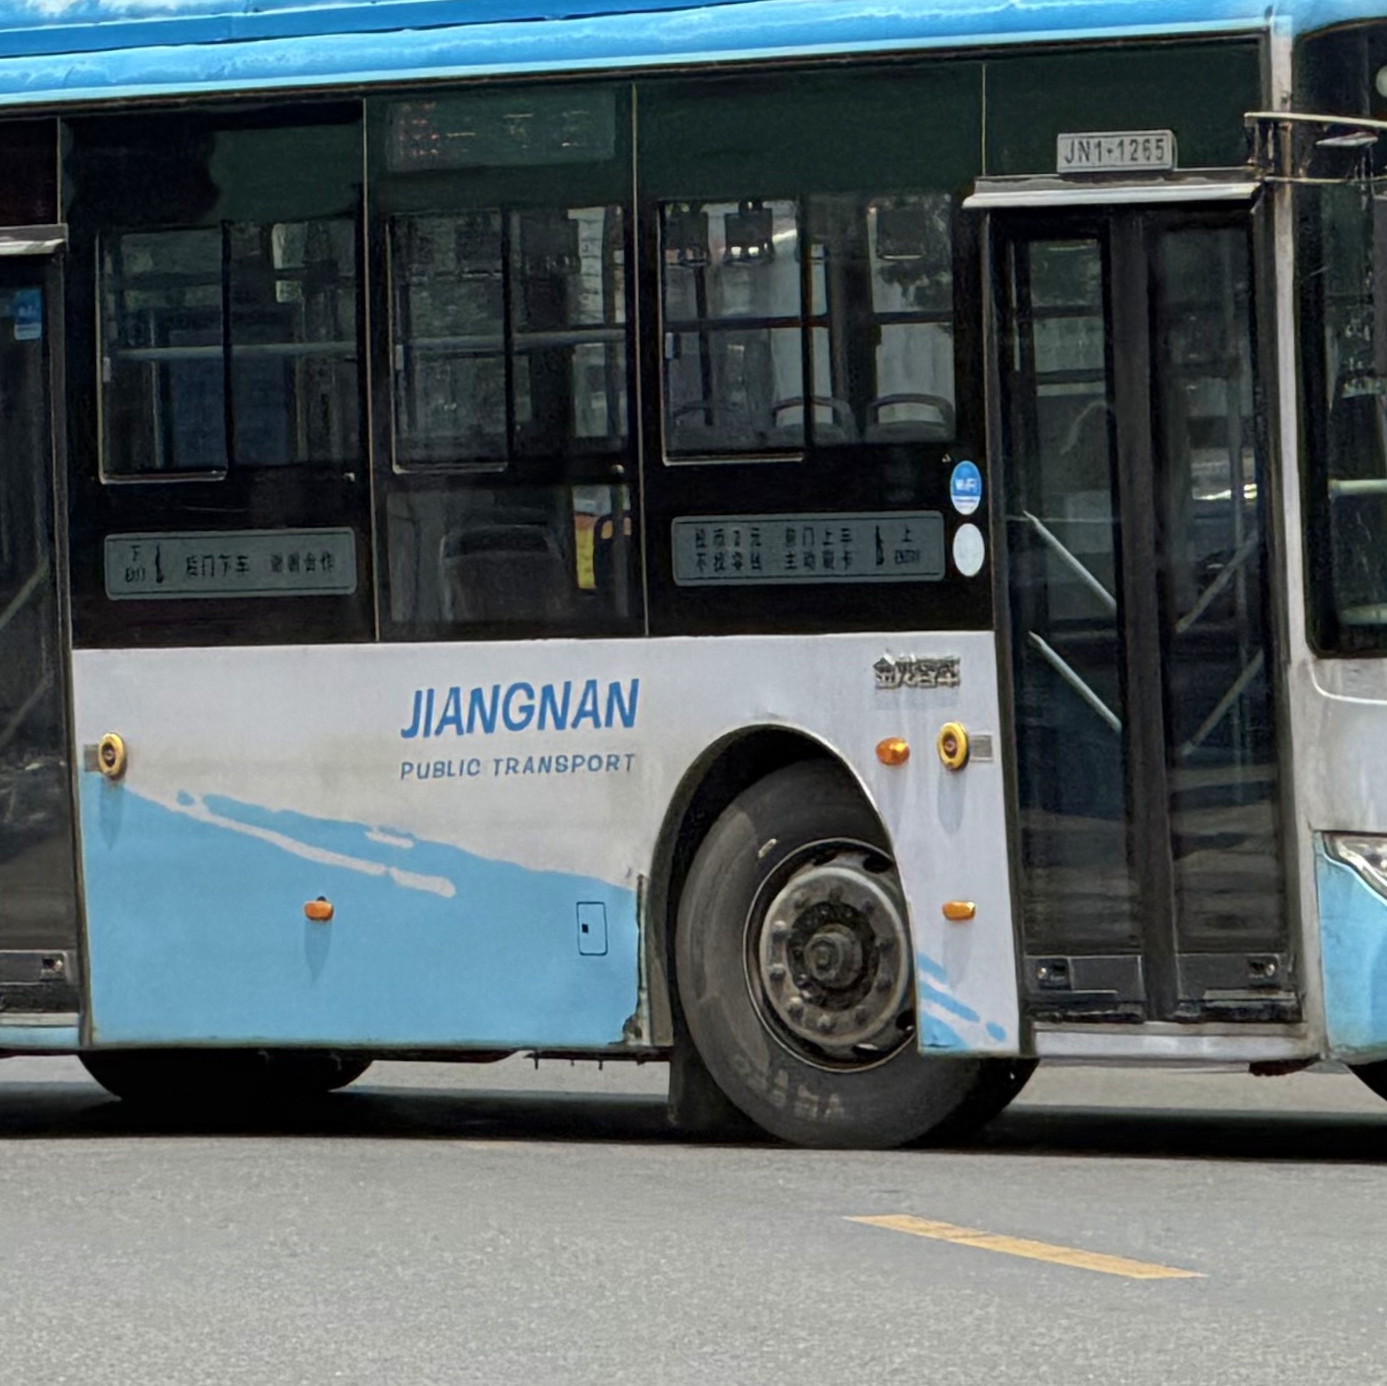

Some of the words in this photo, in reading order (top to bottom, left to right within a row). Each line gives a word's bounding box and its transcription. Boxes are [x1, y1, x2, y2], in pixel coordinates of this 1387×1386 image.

[400, 678, 640, 738] JIANGNAN
[400, 757, 482, 780] PUBLIC
[493, 753, 637, 777] TRANSPORT
